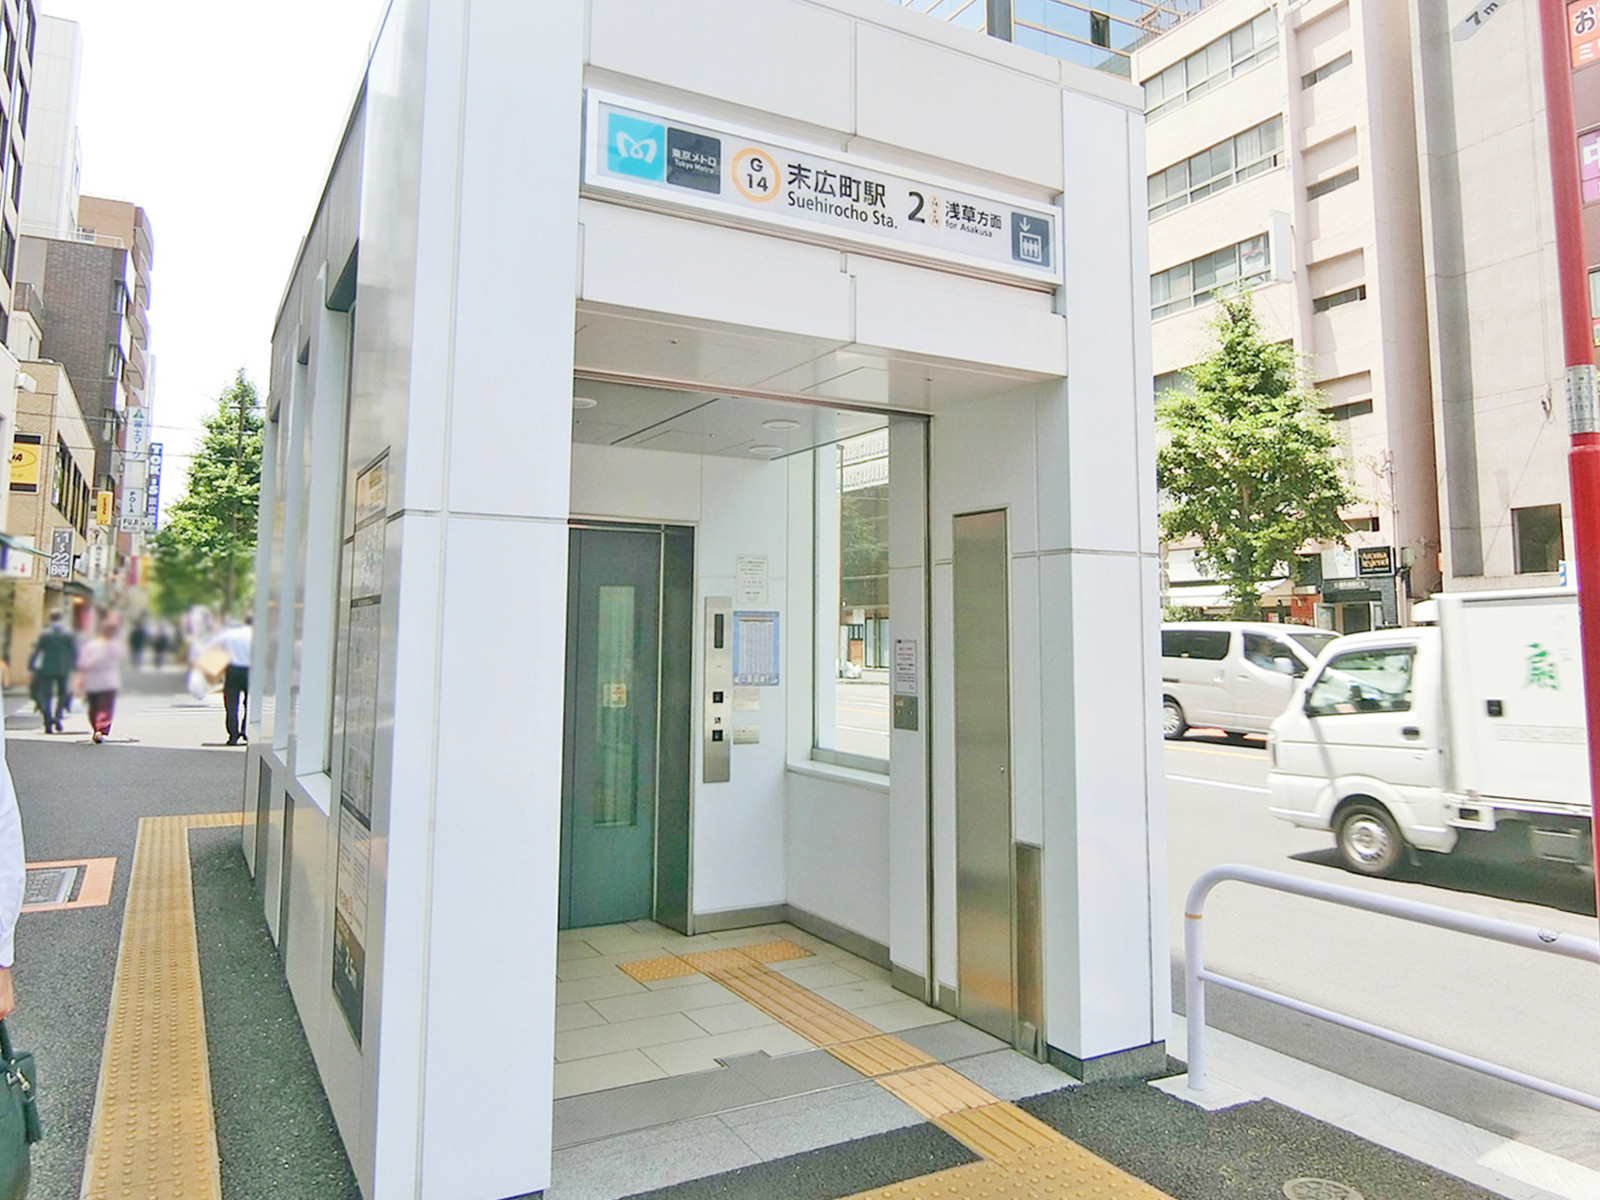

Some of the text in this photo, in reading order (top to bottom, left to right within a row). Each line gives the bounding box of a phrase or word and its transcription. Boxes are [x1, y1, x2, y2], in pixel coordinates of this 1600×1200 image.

[1574, 3, 1600, 34] お
[672, 147, 717, 167] 東京メトロ
[675, 159, 715, 175] Tokyo Metro
[750, 158, 763, 173] G
[747, 173, 769, 192] 14
[787, 163, 886, 209] 末広町駅
[787, 190, 869, 223] Suehirocho
[872, 209, 899, 230] Sta.
[907, 190, 926, 224] 2
[945, 200, 1003, 230] 浅草方面
[945, 219, 994, 239] for Asakusa
[128, 491, 136, 514] POLA
[123, 518, 139, 526] FUJI
